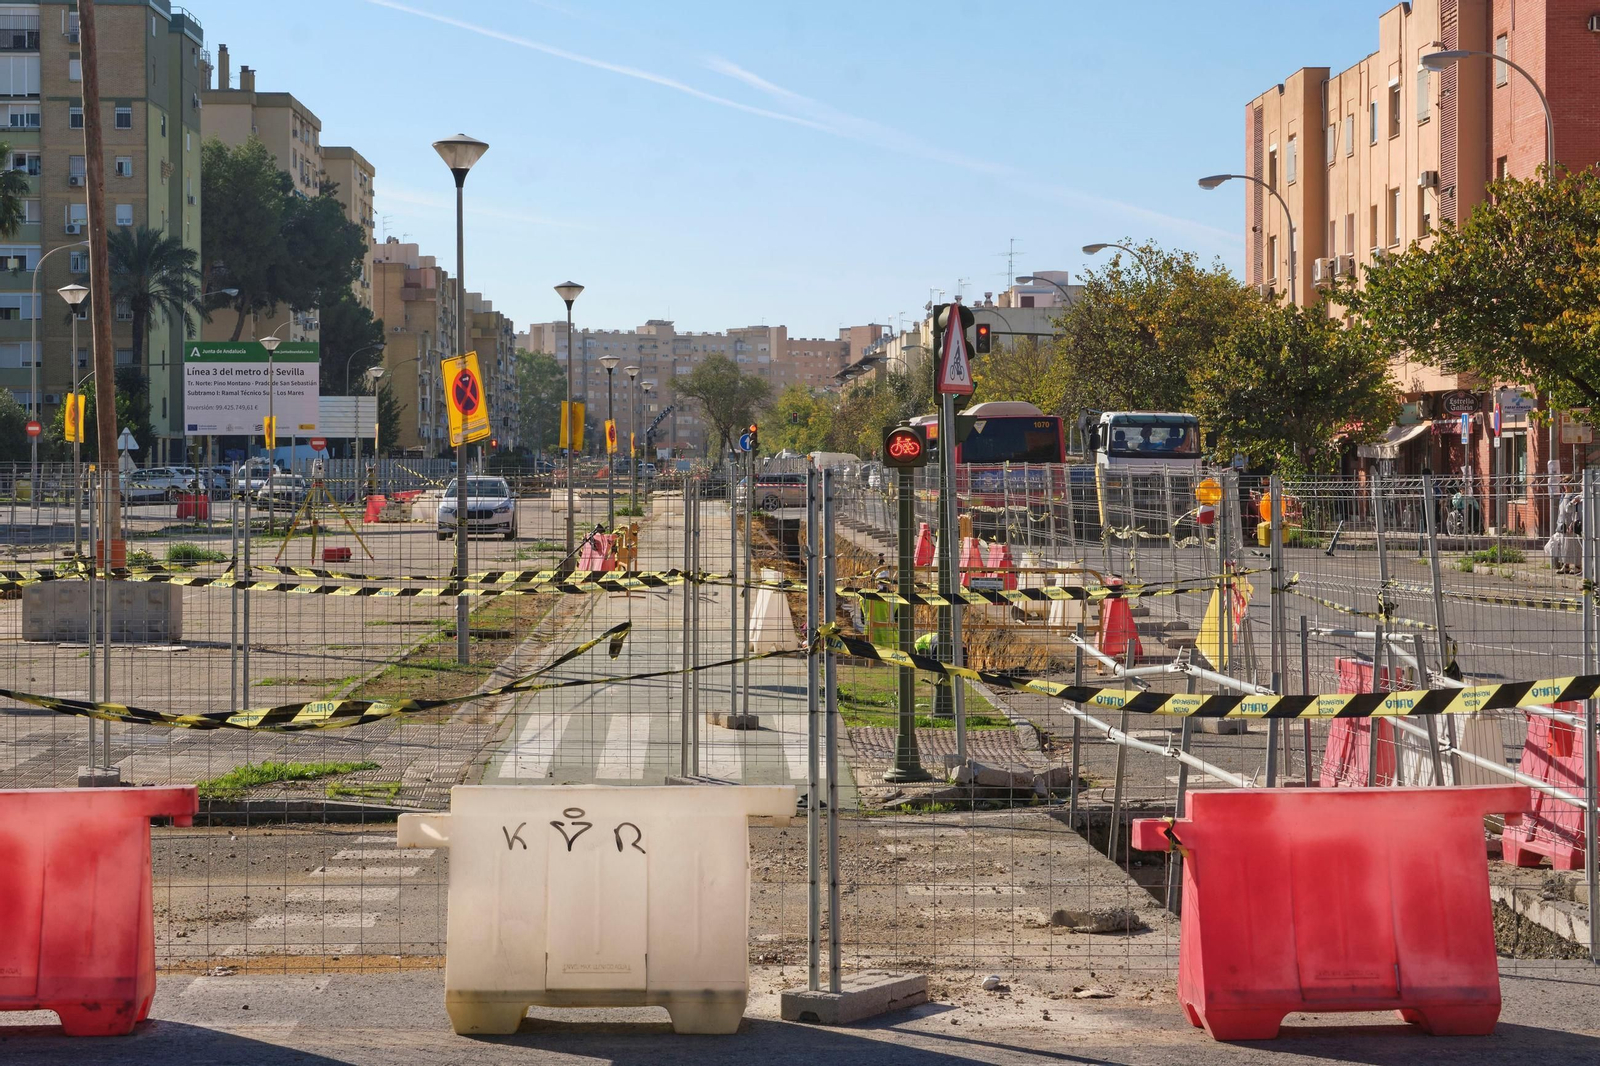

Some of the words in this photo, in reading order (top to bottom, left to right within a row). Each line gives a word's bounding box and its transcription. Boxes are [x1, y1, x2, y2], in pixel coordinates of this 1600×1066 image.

[187, 367, 211, 376] Línea
[219, 368, 233, 376] del
[276, 368, 305, 376] Sevilla
[1449, 397, 1475, 405] Estrella
